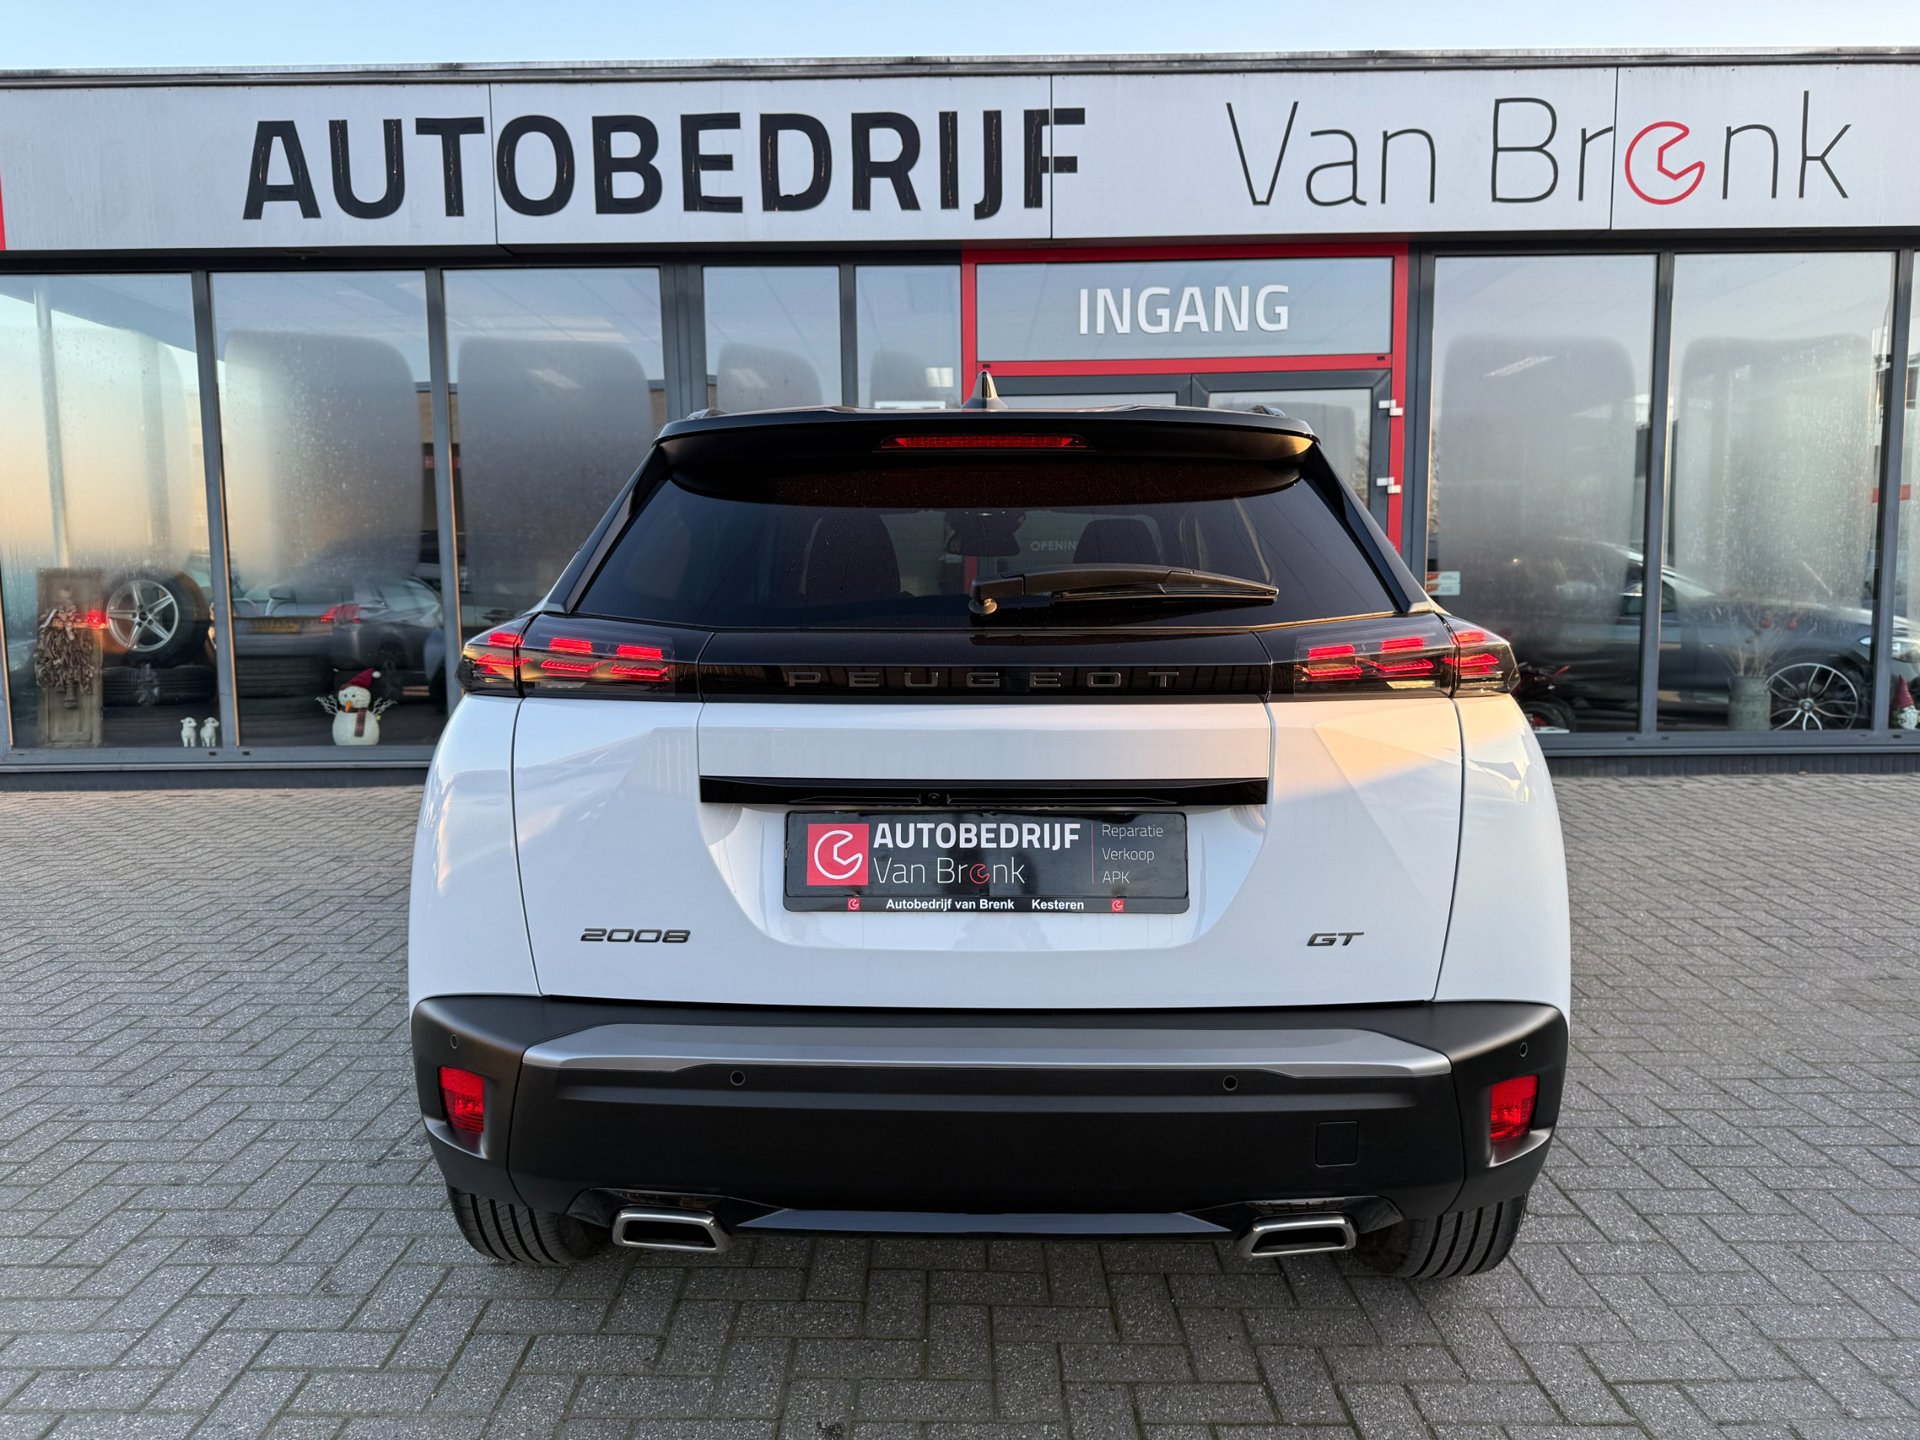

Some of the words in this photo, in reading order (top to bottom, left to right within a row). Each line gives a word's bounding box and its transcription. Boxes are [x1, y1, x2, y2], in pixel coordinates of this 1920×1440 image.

[243, 107, 1085, 220] AUTOBEDRIJF
[1226, 101, 1436, 206] Van
[1079, 284, 1289, 334] INGANG
[1030, 540, 1079, 552] OPENIN
[788, 671, 1180, 688] PEUGEOT
[873, 822, 1081, 851] AUTOBEDRIJF
[1101, 824, 1164, 839] Reparatie
[1101, 848, 1155, 863] Verkoop
[873, 857, 928, 884] Van
[1101, 870, 1130, 884] APK
[886, 899, 952, 911] Autobedrijf
[954, 901, 976, 910] van
[979, 899, 1015, 910] Brenk
[1031, 899, 1085, 910] Kesteren
[580, 928, 691, 943] 2008
[1307, 932, 1365, 947] GT
